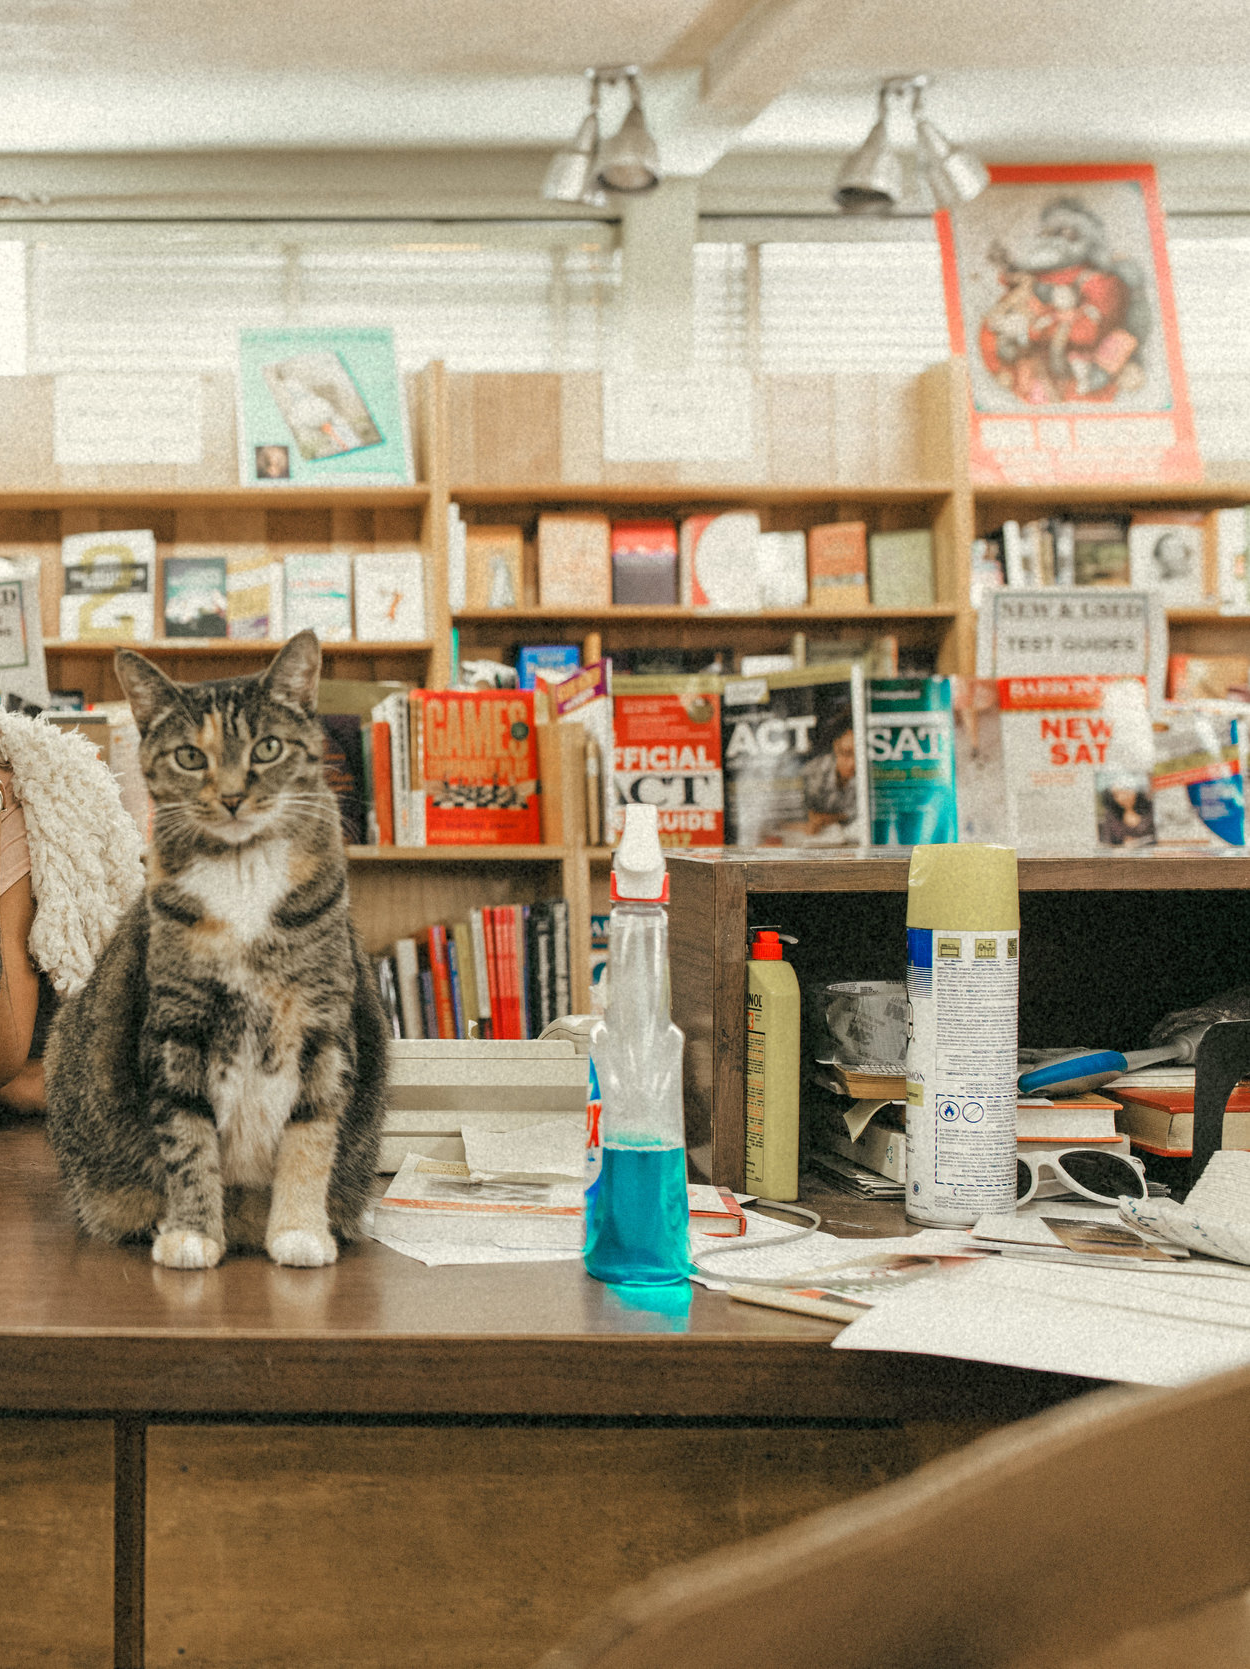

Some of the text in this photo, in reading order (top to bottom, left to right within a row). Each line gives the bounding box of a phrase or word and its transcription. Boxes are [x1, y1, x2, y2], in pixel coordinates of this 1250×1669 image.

[1001, 602, 1049, 619] NEW
[1081, 602, 1143, 619] USED
[1007, 636, 1136, 650] TEST GUIDES
[426, 699, 530, 758] GAMES
[725, 714, 818, 759] ACT
[1040, 717, 1113, 740] NEW
[867, 726, 950, 762] SAT
[1049, 743, 1108, 766] SAT
[613, 745, 716, 769] FFICIAL
